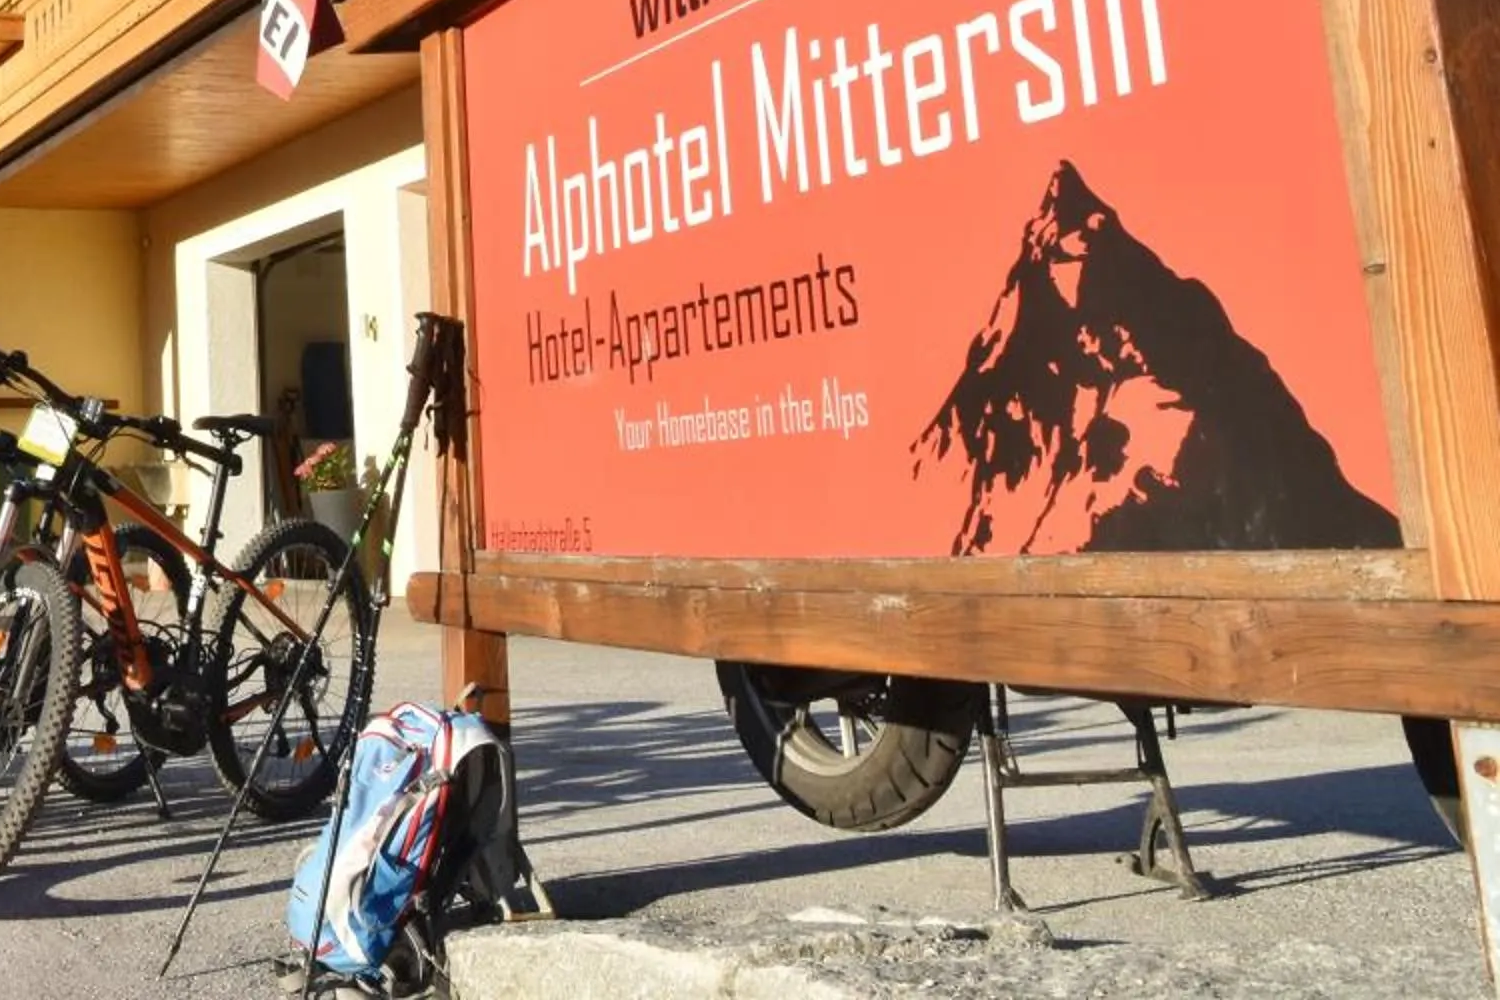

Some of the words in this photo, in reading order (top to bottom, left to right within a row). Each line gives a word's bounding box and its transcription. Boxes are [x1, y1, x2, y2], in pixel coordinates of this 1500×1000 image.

[523, 60, 733, 295] Alphotel
[526, 252, 859, 385] Hotel-Appartements
[614, 407, 652, 450] Your
[657, 395, 750, 447] Homebase
[756, 394, 775, 437] in
[780, 383, 815, 434] the
[821, 376, 869, 440] Alps
